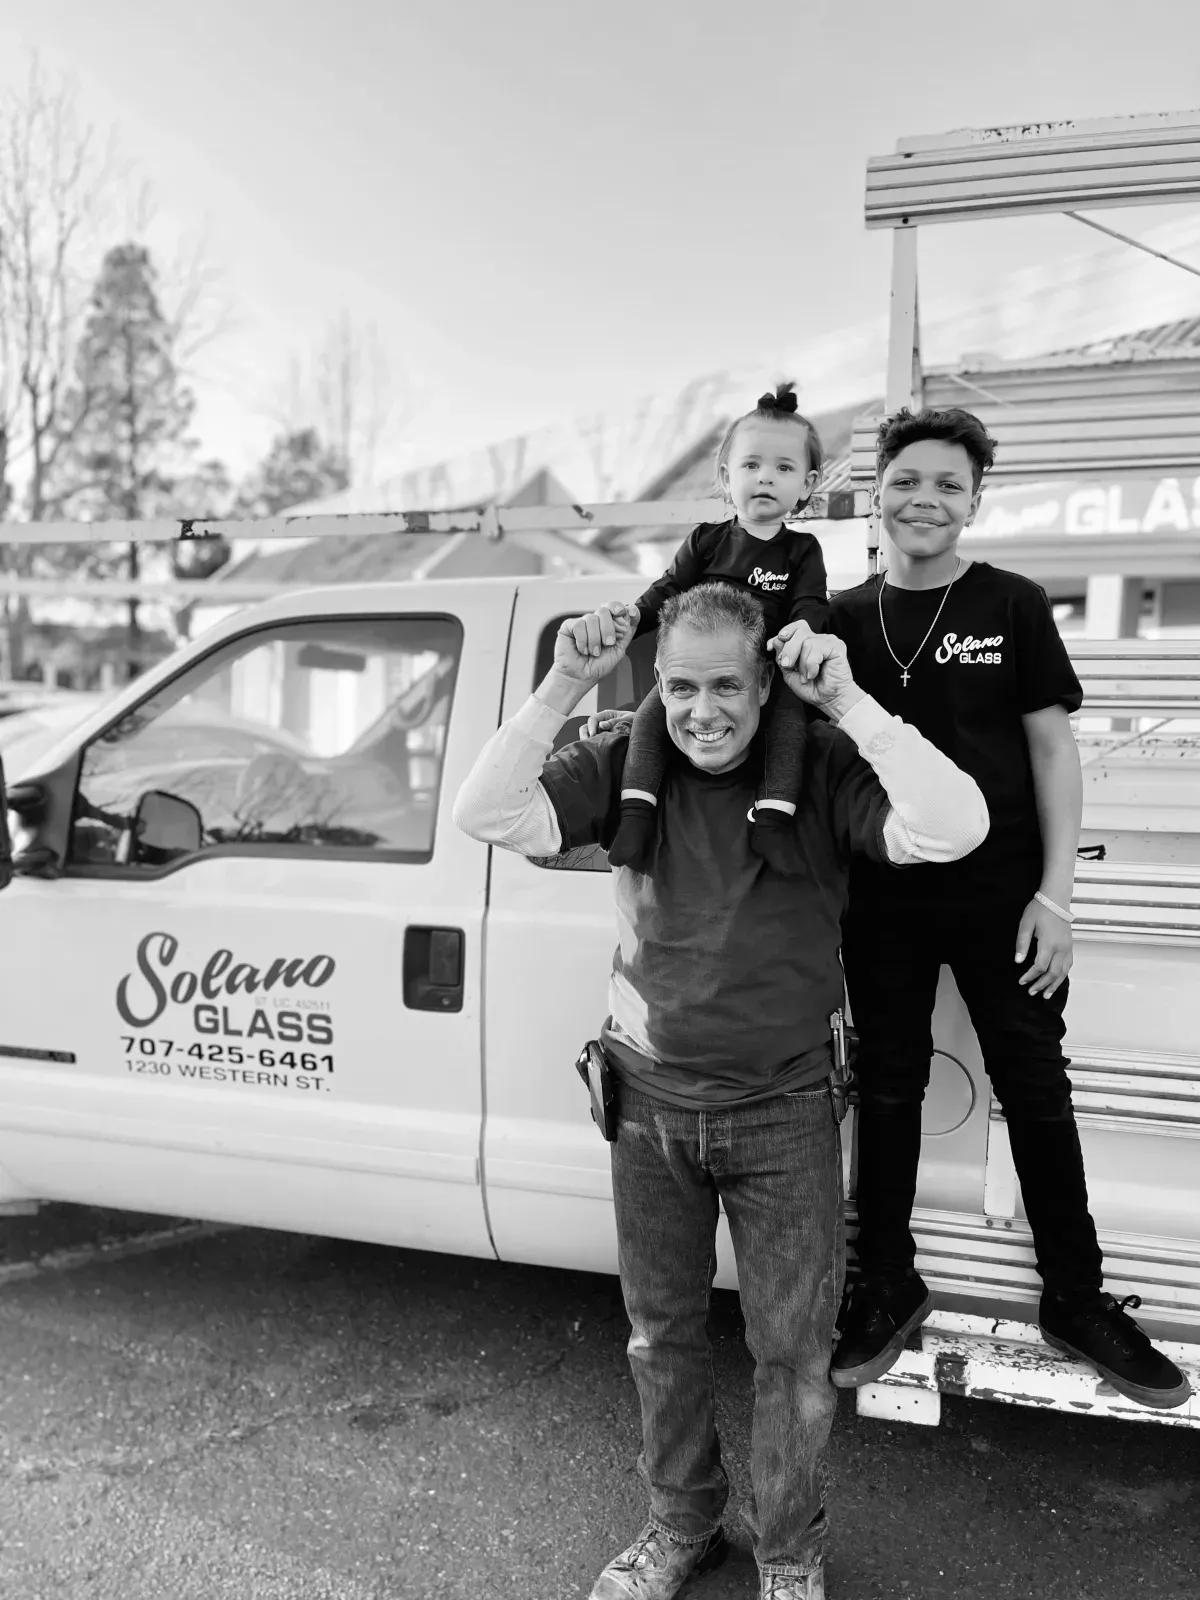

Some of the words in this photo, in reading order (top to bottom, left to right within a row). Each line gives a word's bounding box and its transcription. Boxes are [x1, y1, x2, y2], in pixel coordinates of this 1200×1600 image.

[1065, 476, 1200, 534] GLA
[748, 567, 789, 586] Solano
[762, 581, 787, 590] GLASS
[935, 632, 1004, 664] Solano
[959, 652, 1002, 664] GLASS
[116, 932, 336, 1028] Solano
[194, 1003, 334, 1045] GLASS
[120, 1036, 335, 1073] 707-425-6461
[125, 1060, 171, 1076] 1230
[177, 1064, 288, 1087] WESTERN
[296, 1075, 331, 1092] ST.
